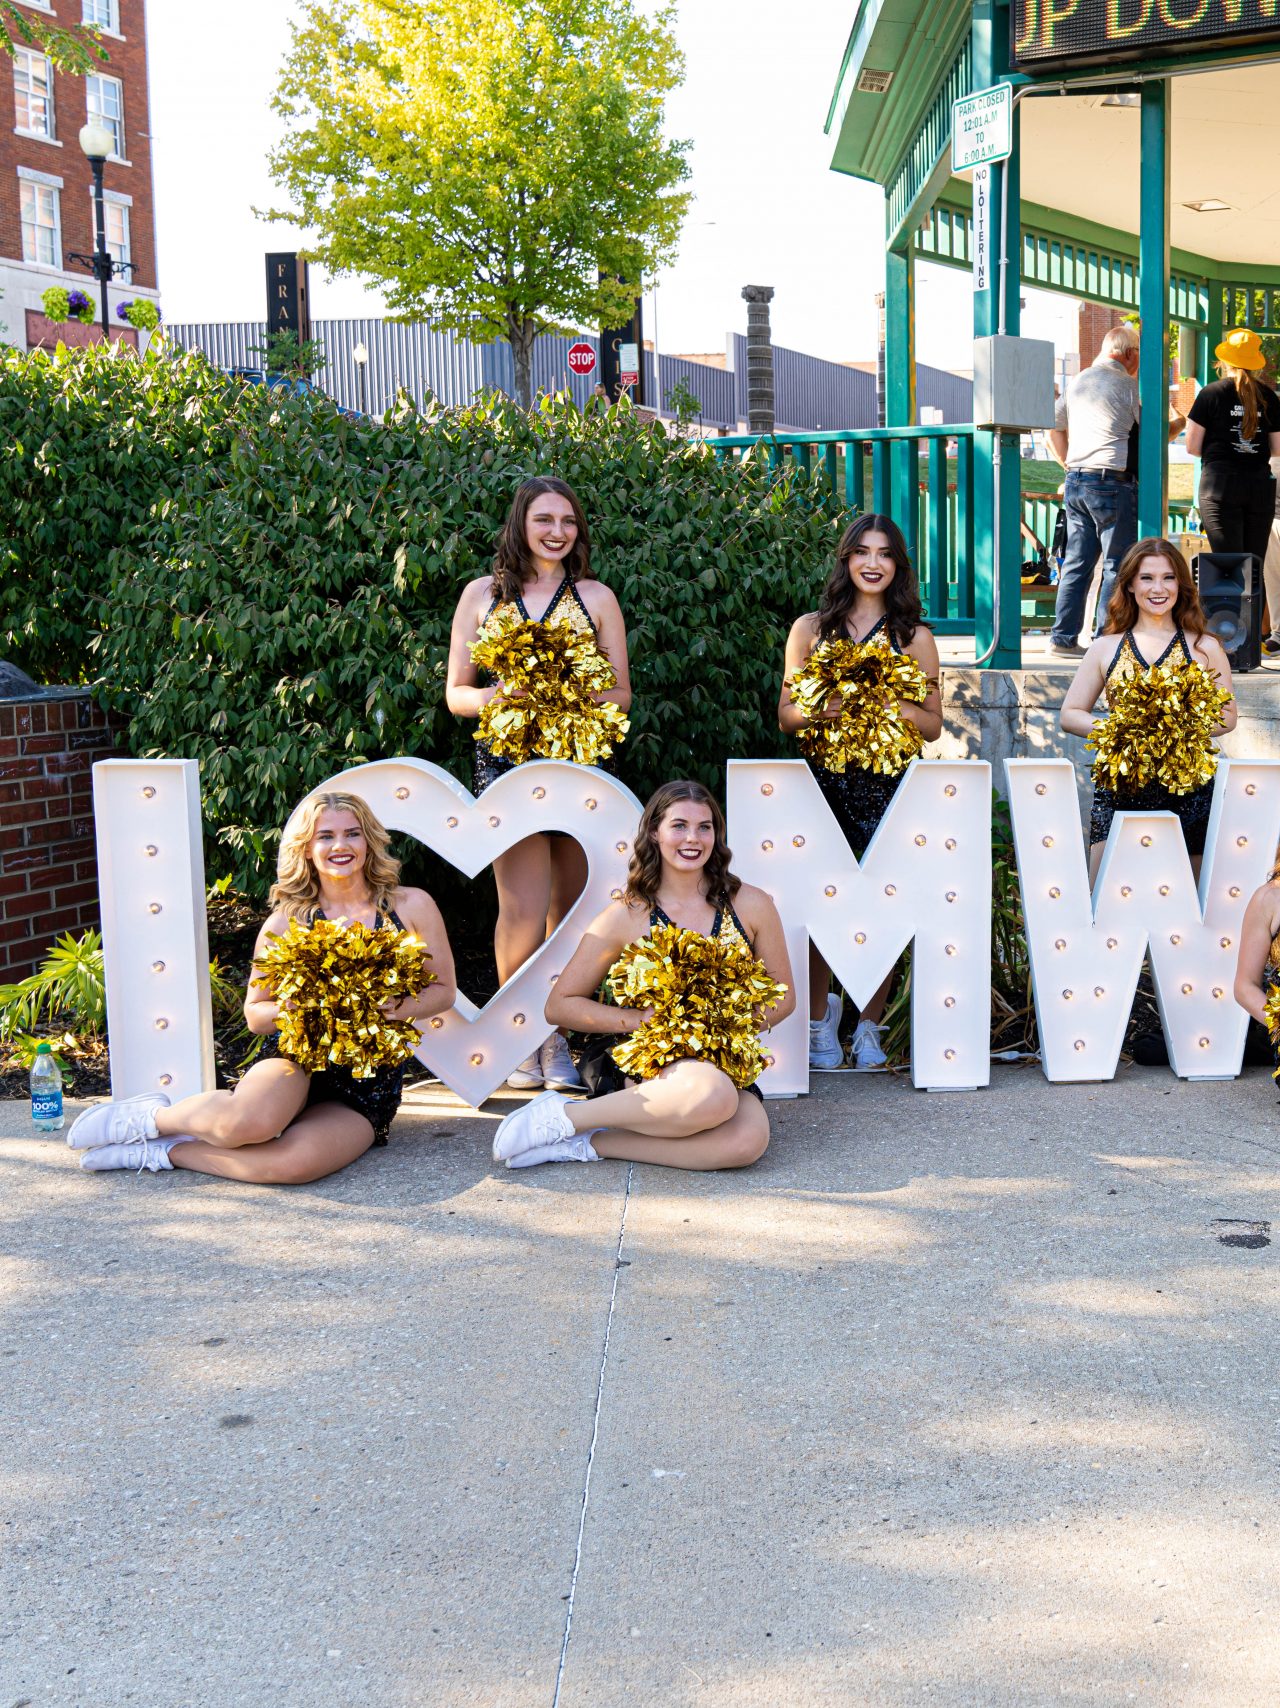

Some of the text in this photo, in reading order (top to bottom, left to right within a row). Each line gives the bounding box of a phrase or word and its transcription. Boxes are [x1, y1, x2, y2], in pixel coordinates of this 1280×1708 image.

[958, 91, 1005, 117] PARK CLOSED
[964, 116, 983, 132] 12:01
[975, 132, 985, 144] TO
[964, 148, 980, 163] 6:00
[975, 169, 987, 181] NO
[569, 352, 595, 366] STOP
[32, 1101, 58, 1110] 100%
